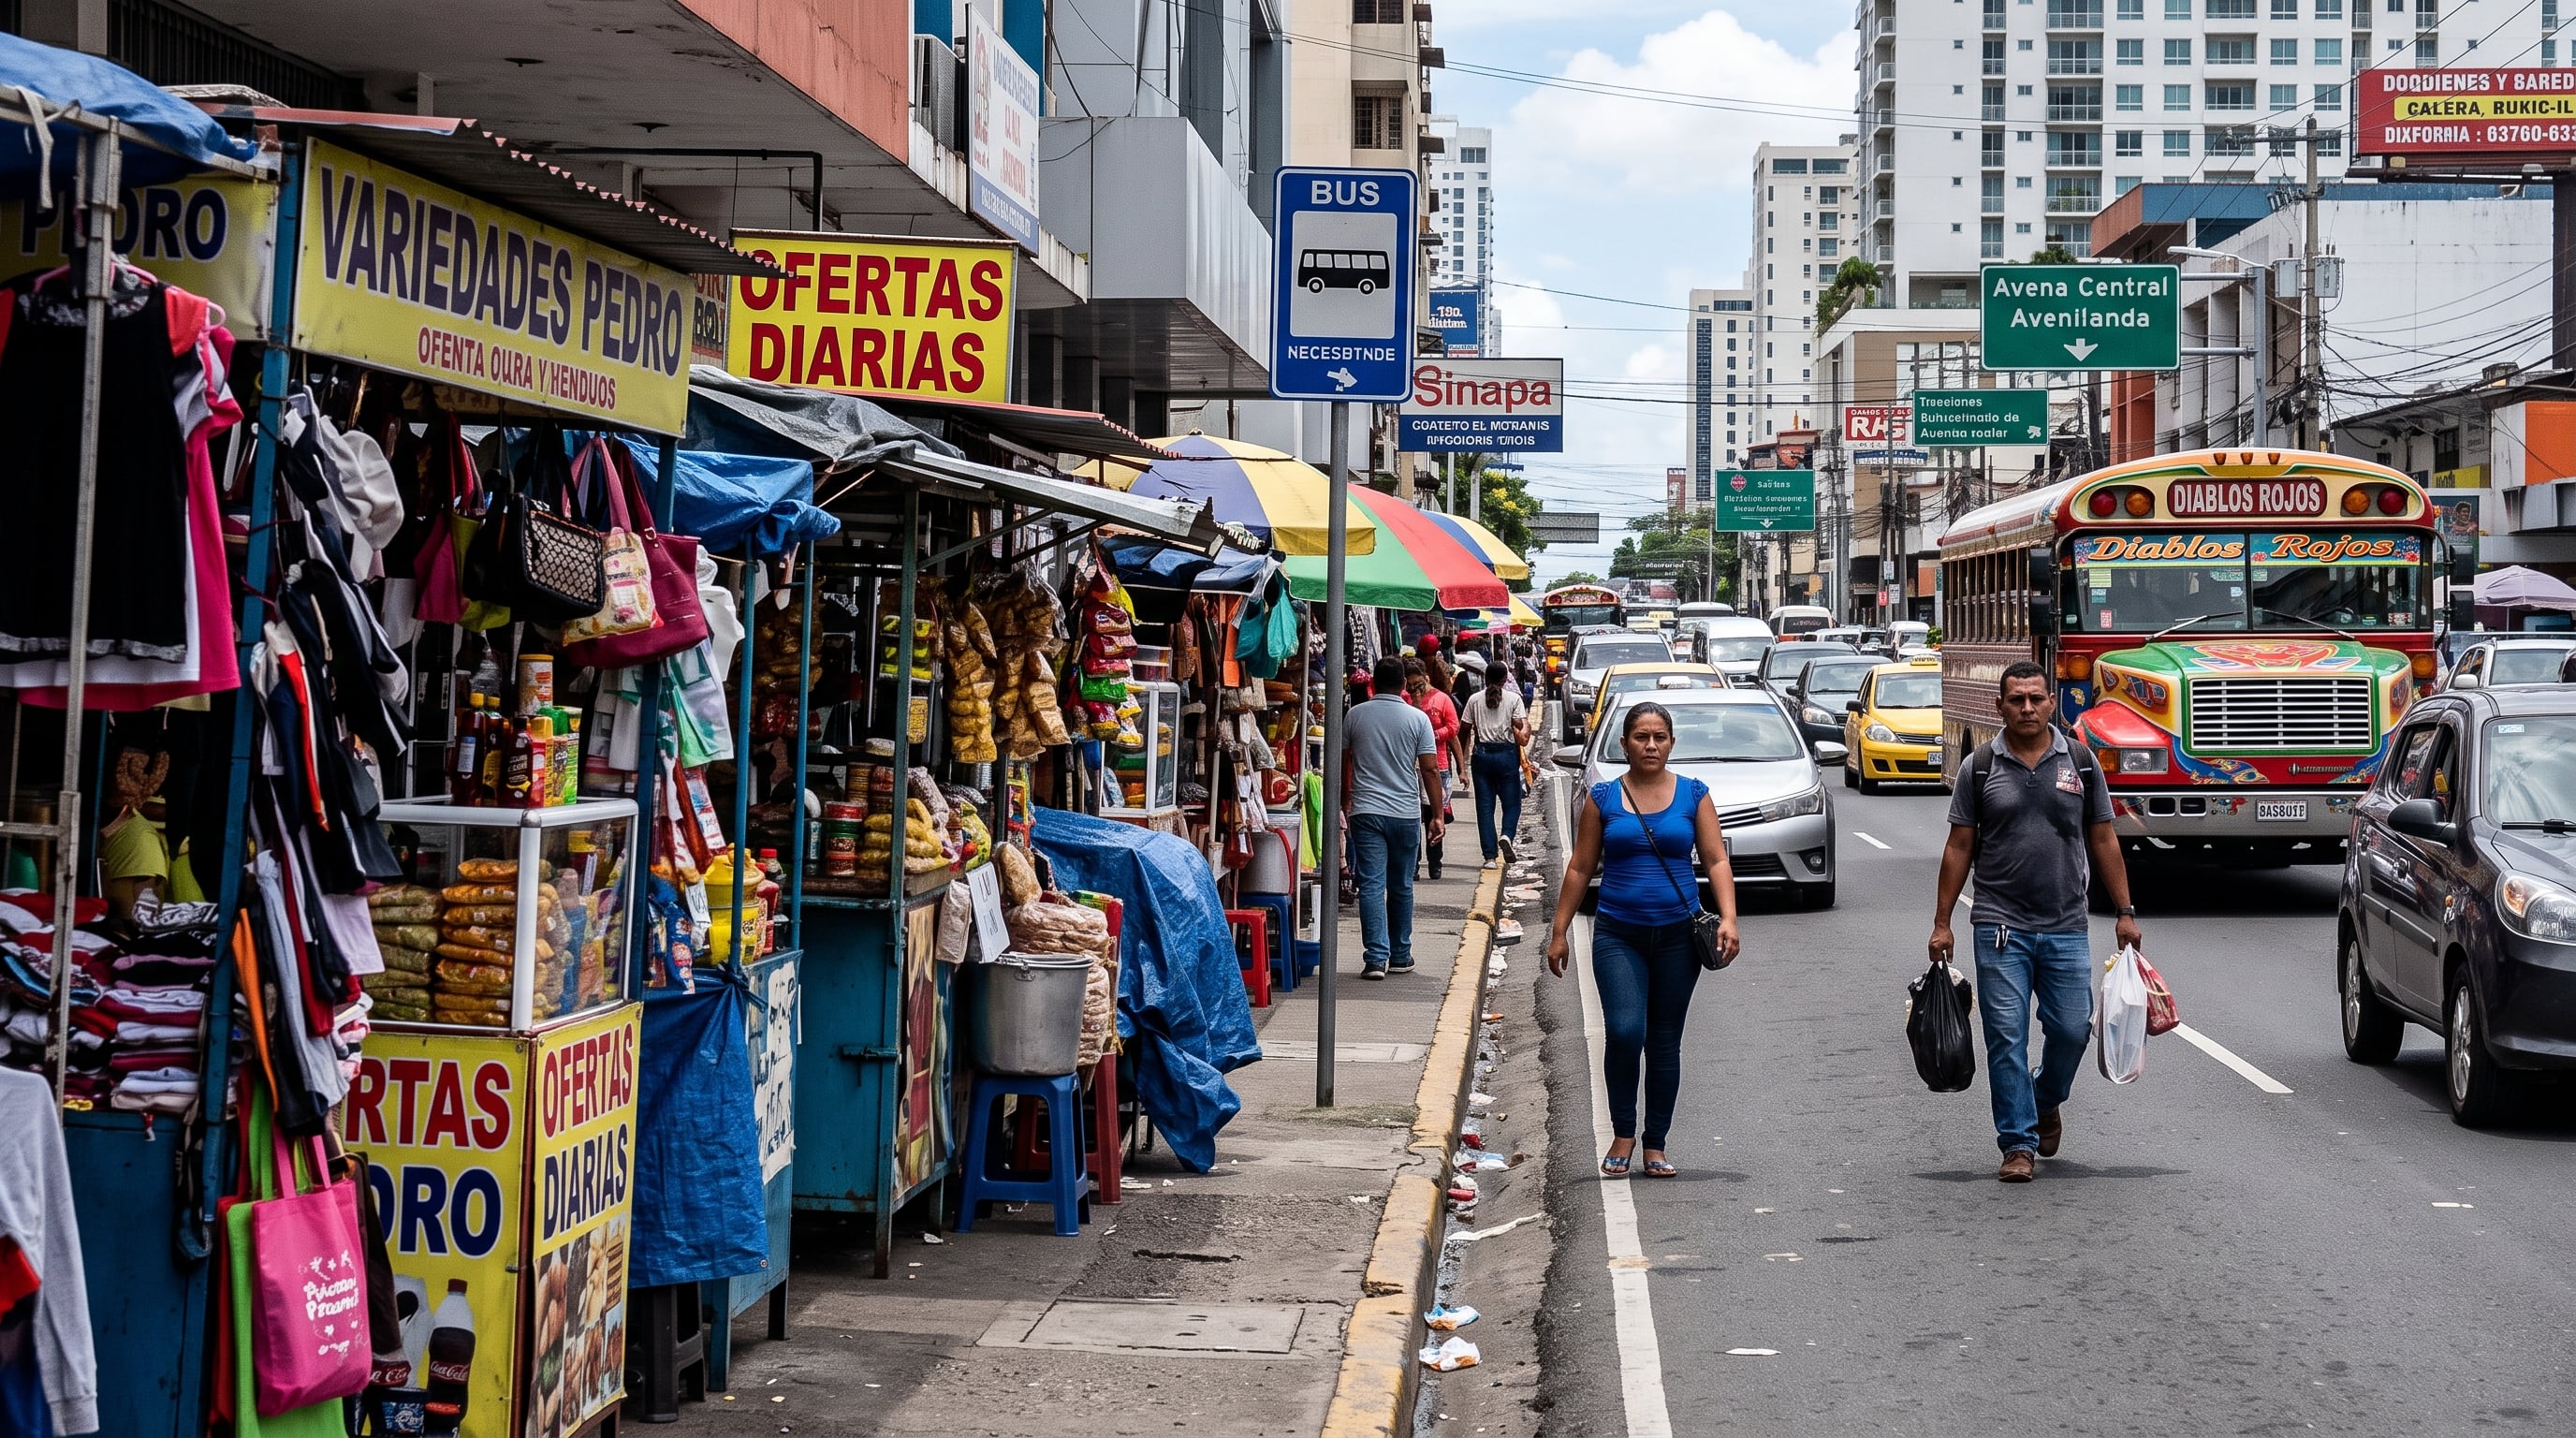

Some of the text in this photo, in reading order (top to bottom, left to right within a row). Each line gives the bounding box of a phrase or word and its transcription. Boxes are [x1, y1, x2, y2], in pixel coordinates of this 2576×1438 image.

[2496, 74, 2509, 91] Y
[1310, 180, 1380, 207] BUS
[320, 164, 683, 377] VARIEDADES PEDRO
[739, 249, 1003, 322] OFERTAS
[1993, 275, 2168, 297] Avena Central
[2010, 307, 2150, 328] Avenilanda
[418, 327, 485, 378] OFENTA
[538, 358, 548, 393] Y
[550, 360, 616, 410] HENDUOS
[750, 323, 985, 394] DIARIAS
[1413, 364, 1552, 414] Sinapa
[2004, 412, 2020, 422] de
[2174, 482, 2320, 513] DIABLOS ROJOS
[2088, 534, 2395, 563] Diablos Rojos
[543, 1021, 633, 1138] OFERTAS
[543, 1123, 629, 1242] DIARIAS
